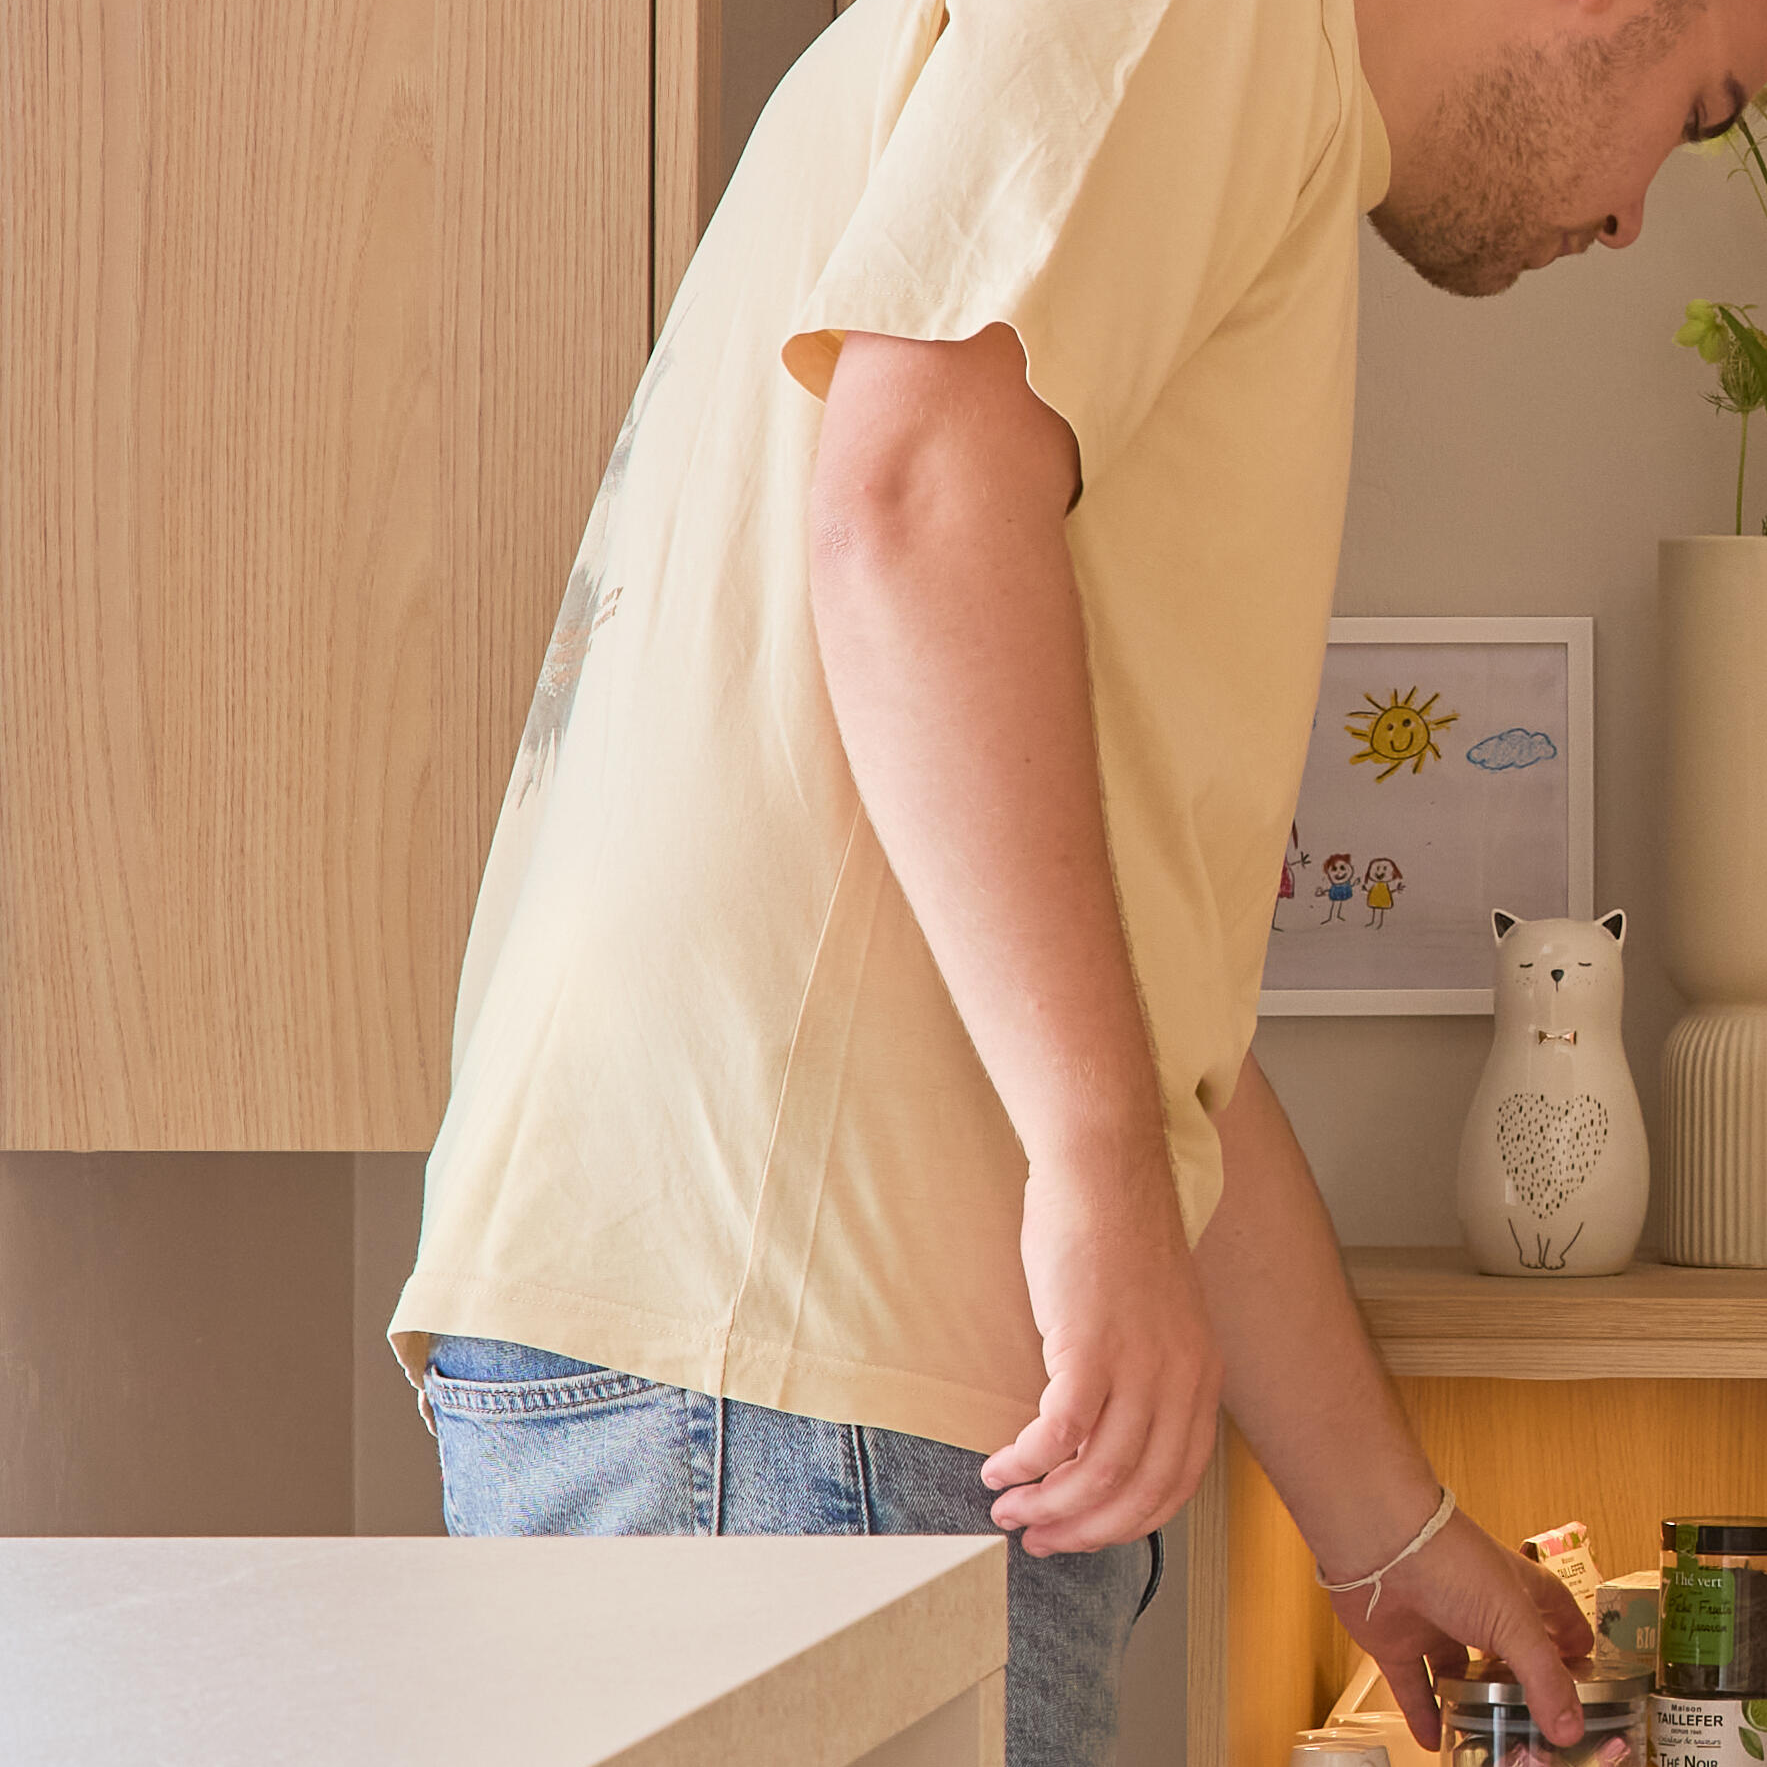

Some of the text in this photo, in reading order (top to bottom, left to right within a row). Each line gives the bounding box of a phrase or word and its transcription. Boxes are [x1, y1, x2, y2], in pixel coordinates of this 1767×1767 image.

[1674, 1571, 1723, 1589] Thé vert
[1636, 1626, 1656, 1650] BIO
[1671, 1704, 1702, 1713] Maison
[1656, 1712, 1724, 1727] TAILLEFER
